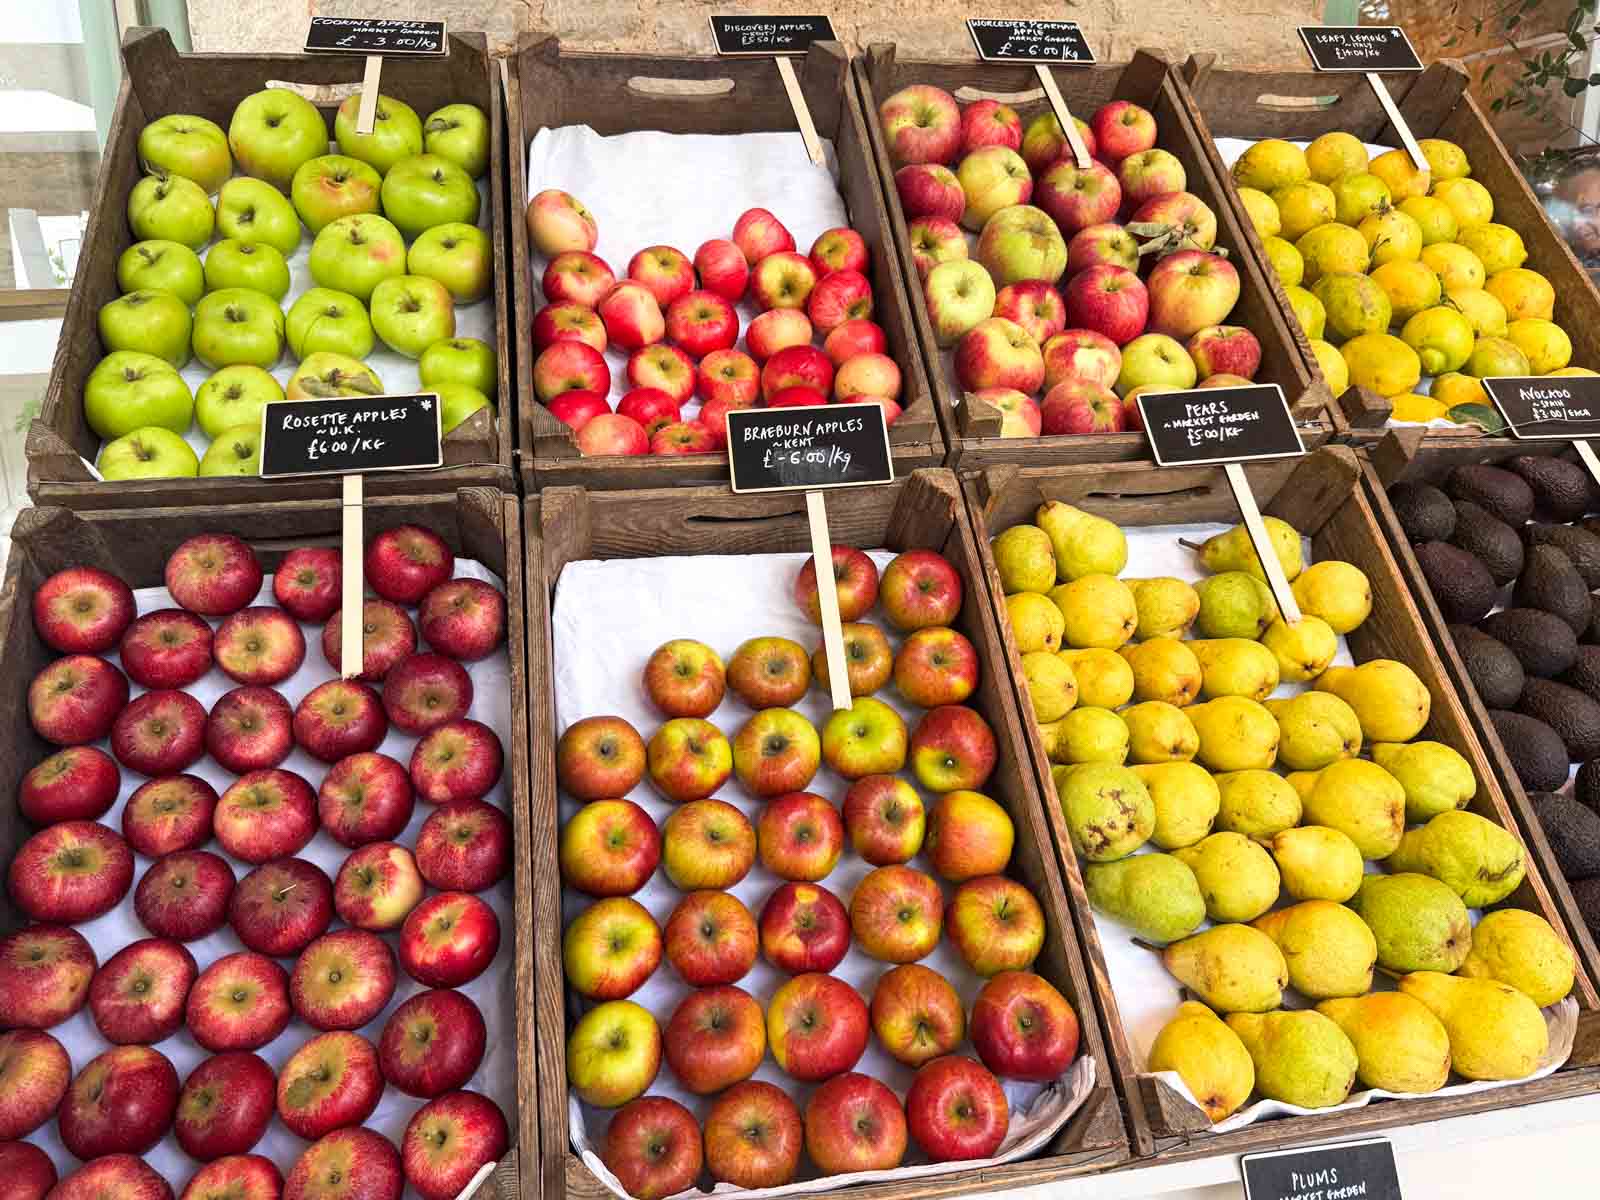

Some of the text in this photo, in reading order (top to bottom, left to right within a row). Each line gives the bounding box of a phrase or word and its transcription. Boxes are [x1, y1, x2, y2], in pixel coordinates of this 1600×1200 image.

[312, 18, 427, 29] COOKING APPLES
[971, 20, 1027, 28] WORCESTER
[1315, 34, 1387, 44] LEAFY LEMONS
[1519, 386, 1571, 401] AVOCADO
[1185, 401, 1228, 418] PEARS
[1219, 411, 1260, 424] GARDEN
[282, 407, 408, 430] ROSETTE APPLES
[743, 418, 863, 443] BRAEBURN APPLES
[1291, 1168, 1338, 1191] PLUMS
[1326, 1181, 1367, 1200] GARDEN
